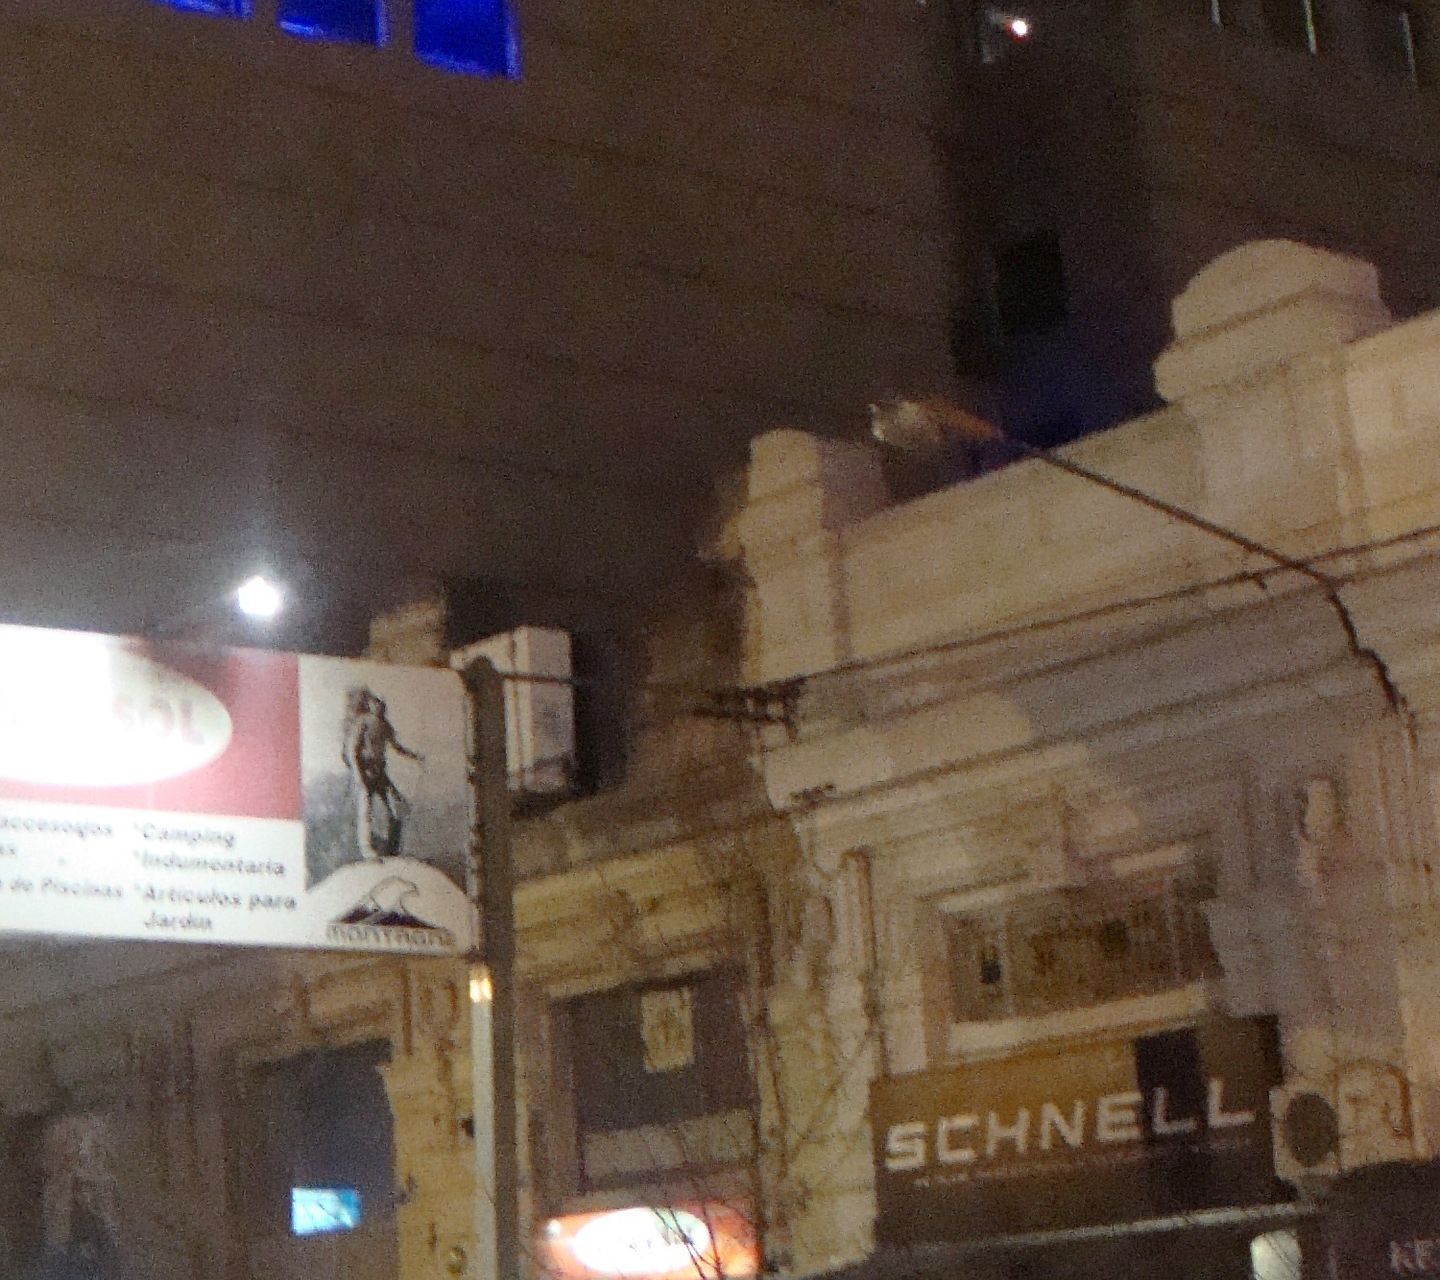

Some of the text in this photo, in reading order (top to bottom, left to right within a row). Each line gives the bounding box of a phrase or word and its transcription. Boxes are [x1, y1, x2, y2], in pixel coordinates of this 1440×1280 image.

[142, 821, 237, 851] Camping
[142, 848, 286, 878] Indumentaria
[9, 874, 34, 893] de
[40, 876, 124, 900] Piscinas
[247, 893, 298, 916] para
[885, 1077, 1258, 1172] SCHNELL
